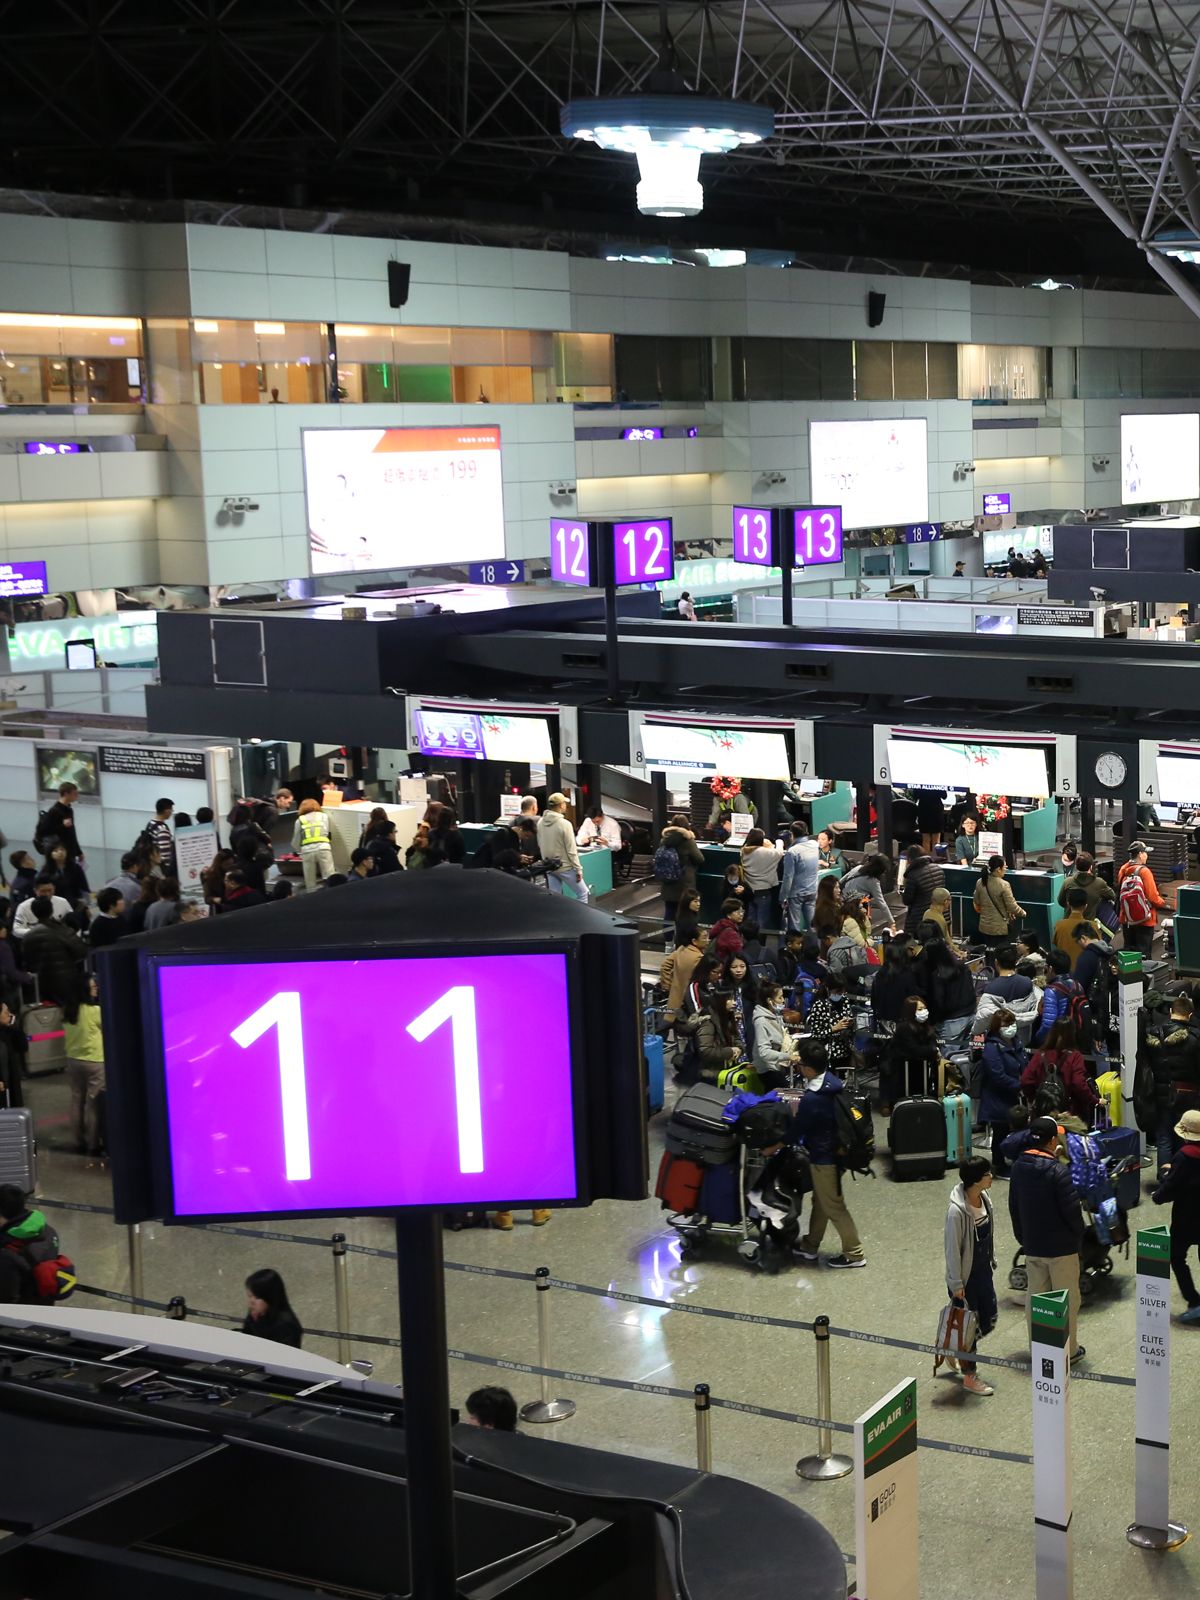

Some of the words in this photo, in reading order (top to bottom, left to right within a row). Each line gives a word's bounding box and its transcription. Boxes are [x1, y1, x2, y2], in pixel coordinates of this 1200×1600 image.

[450, 460, 477, 480] 199
[739, 514, 767, 559] 13
[801, 513, 835, 558] 13
[912, 527, 922, 542] 18
[556, 527, 585, 578] 12
[622, 526, 664, 576] 12
[480, 565, 495, 583] 18
[412, 736, 419, 746] 10
[565, 746, 572, 757] 9
[636, 752, 643, 762] 8
[802, 762, 808, 773] 7
[879, 767, 887, 779] 6
[1062, 779, 1070, 791] 5
[1146, 785, 1153, 796] 4
[230, 985, 484, 1180] 11
[562, 1281, 577, 1289] AIR
[608, 1292, 623, 1300] EVA
[624, 1294, 639, 1302] AIR
[1140, 1297, 1166, 1309] SILVER
[686, 1305, 703, 1314] AIR
[734, 1314, 751, 1322] EVA
[751, 1316, 768, 1324] AIR
[850, 1332, 868, 1340] EVA
[868, 1334, 885, 1343] AIR
[1142, 1334, 1164, 1345] ELITE
[918, 1345, 936, 1354] EVA
[936, 1348, 955, 1357] AIR
[1140, 1346, 1166, 1357] CLASS
[497, 1361, 514, 1369] EVA
[515, 1364, 532, 1372] AIR
[990, 1357, 1008, 1367] EVA
[1008, 1360, 1027, 1370] AIR
[564, 1372, 582, 1381] EVA
[582, 1375, 600, 1383] AIR
[1083, 1372, 1102, 1381] AIR
[633, 1384, 650, 1392] EVA
[651, 1386, 669, 1395] AIR
[1036, 1381, 1060, 1394] GOLD
[724, 1401, 742, 1409] EVA
[742, 1404, 761, 1413] AIR
[797, 1417, 816, 1426] EVA
[816, 1419, 835, 1429] AIR
[868, 1424, 886, 1444] EVA
[886, 1406, 902, 1426] AIR
[950, 1445, 969, 1454] EVA
[970, 1447, 990, 1456] AIR
[880, 1483, 896, 1504] GOLD
